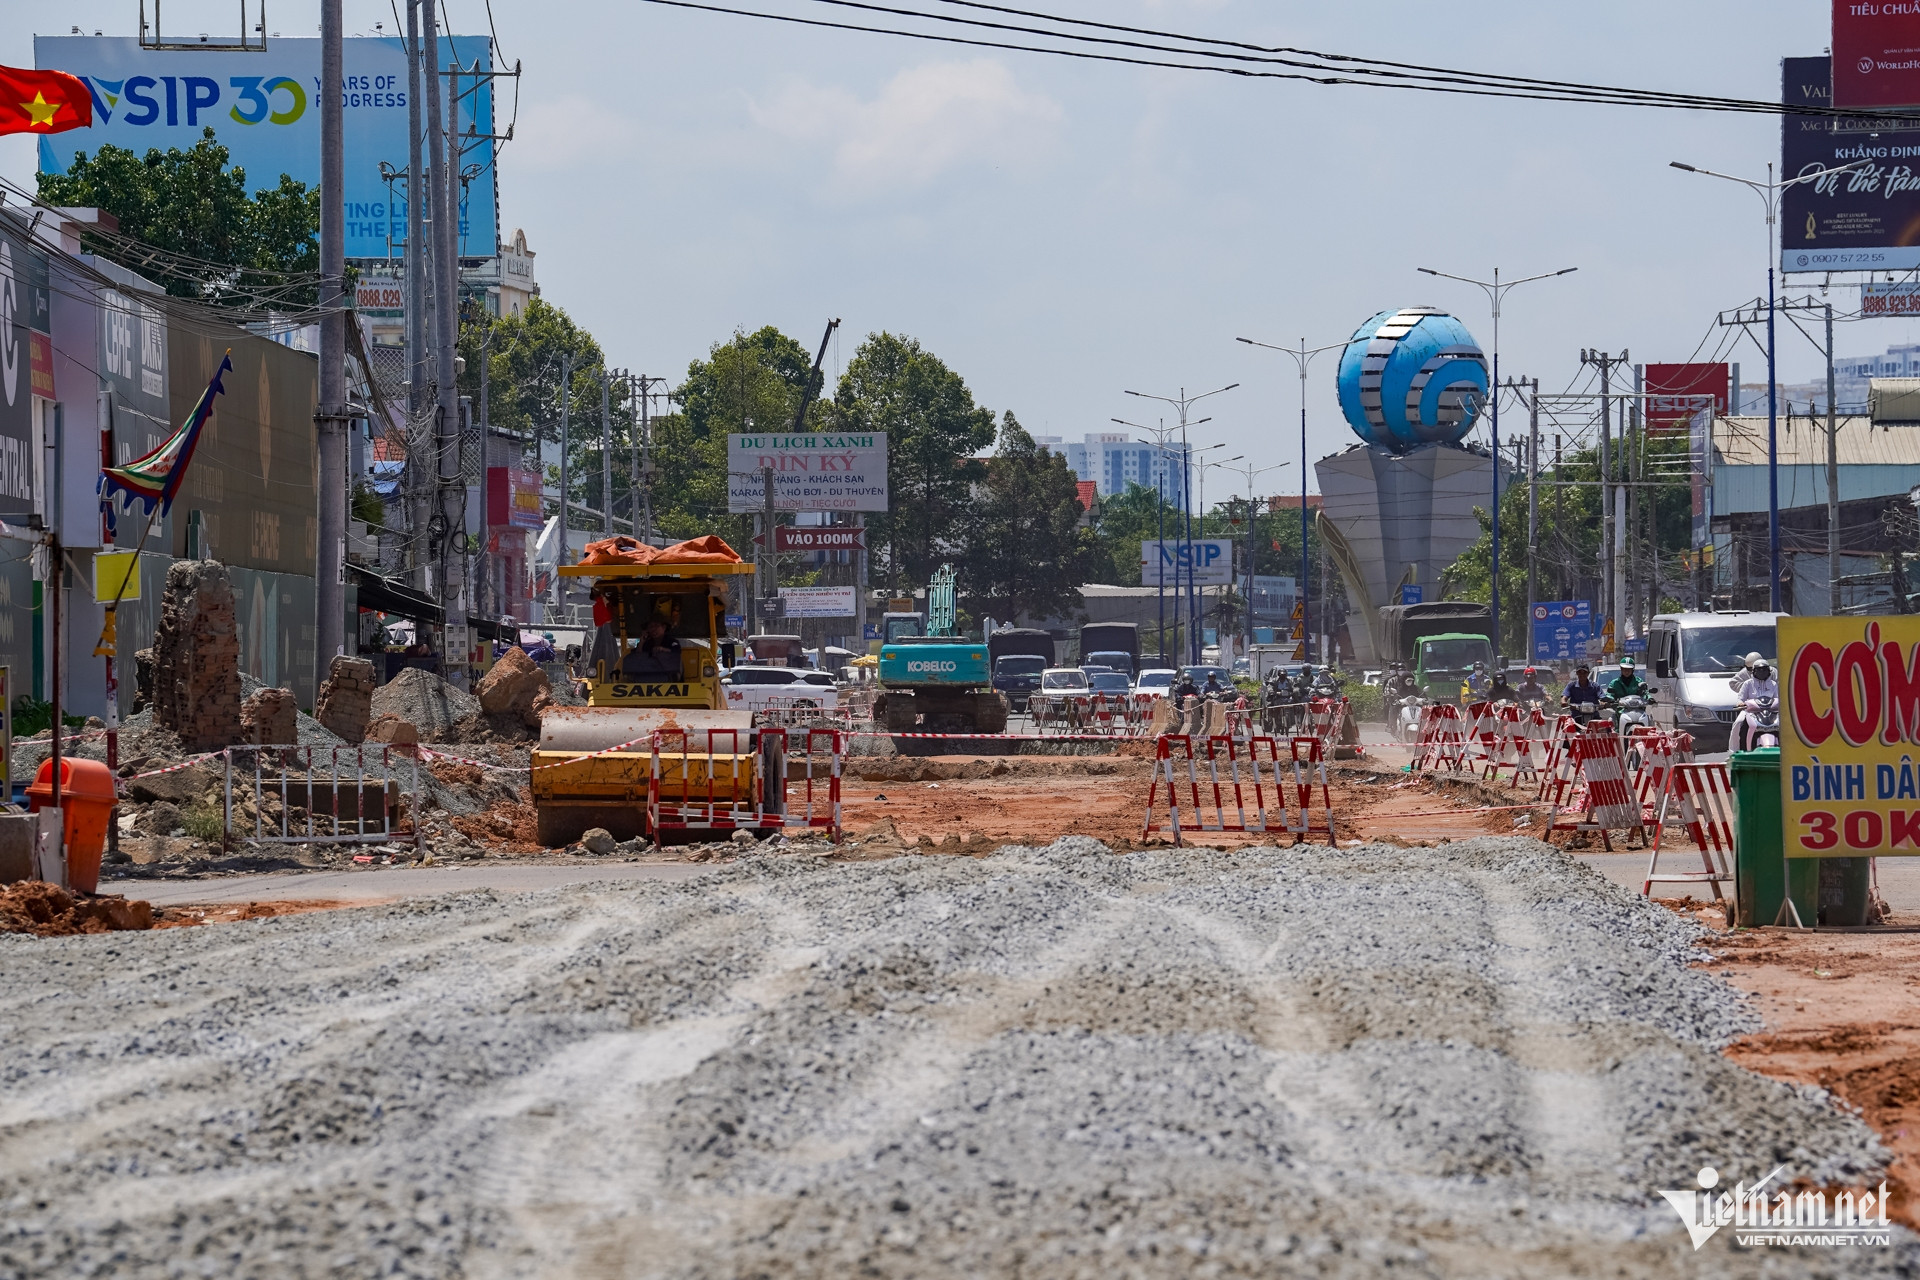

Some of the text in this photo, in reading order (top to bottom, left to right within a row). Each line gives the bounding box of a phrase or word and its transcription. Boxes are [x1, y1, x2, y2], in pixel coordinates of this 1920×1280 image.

[1849, 2, 1879, 15] TIÊU
[375, 75, 396, 89] OF
[347, 222, 382, 237] THE
[1812, 253, 1885, 263] 0907 57 22 55
[105, 292, 132, 380] CBRE
[1650, 397, 1724, 412] ISUZU
[740, 436, 874, 451] DU LỊCH XANH
[757, 450, 858, 471] DÌN KÝ
[808, 475, 842, 484] KHÁCH
[844, 475, 865, 486] SẠN
[816, 533, 853, 545] 100M
[1152, 544, 1221, 567] VSIP
[1565, 608, 1573, 616] 60
[908, 661, 956, 672] KOBELCO
[611, 685, 689, 697] SAKAI
[1792, 755, 1920, 801] BÌNH DÂ
[1800, 810, 1920, 850] 30K
